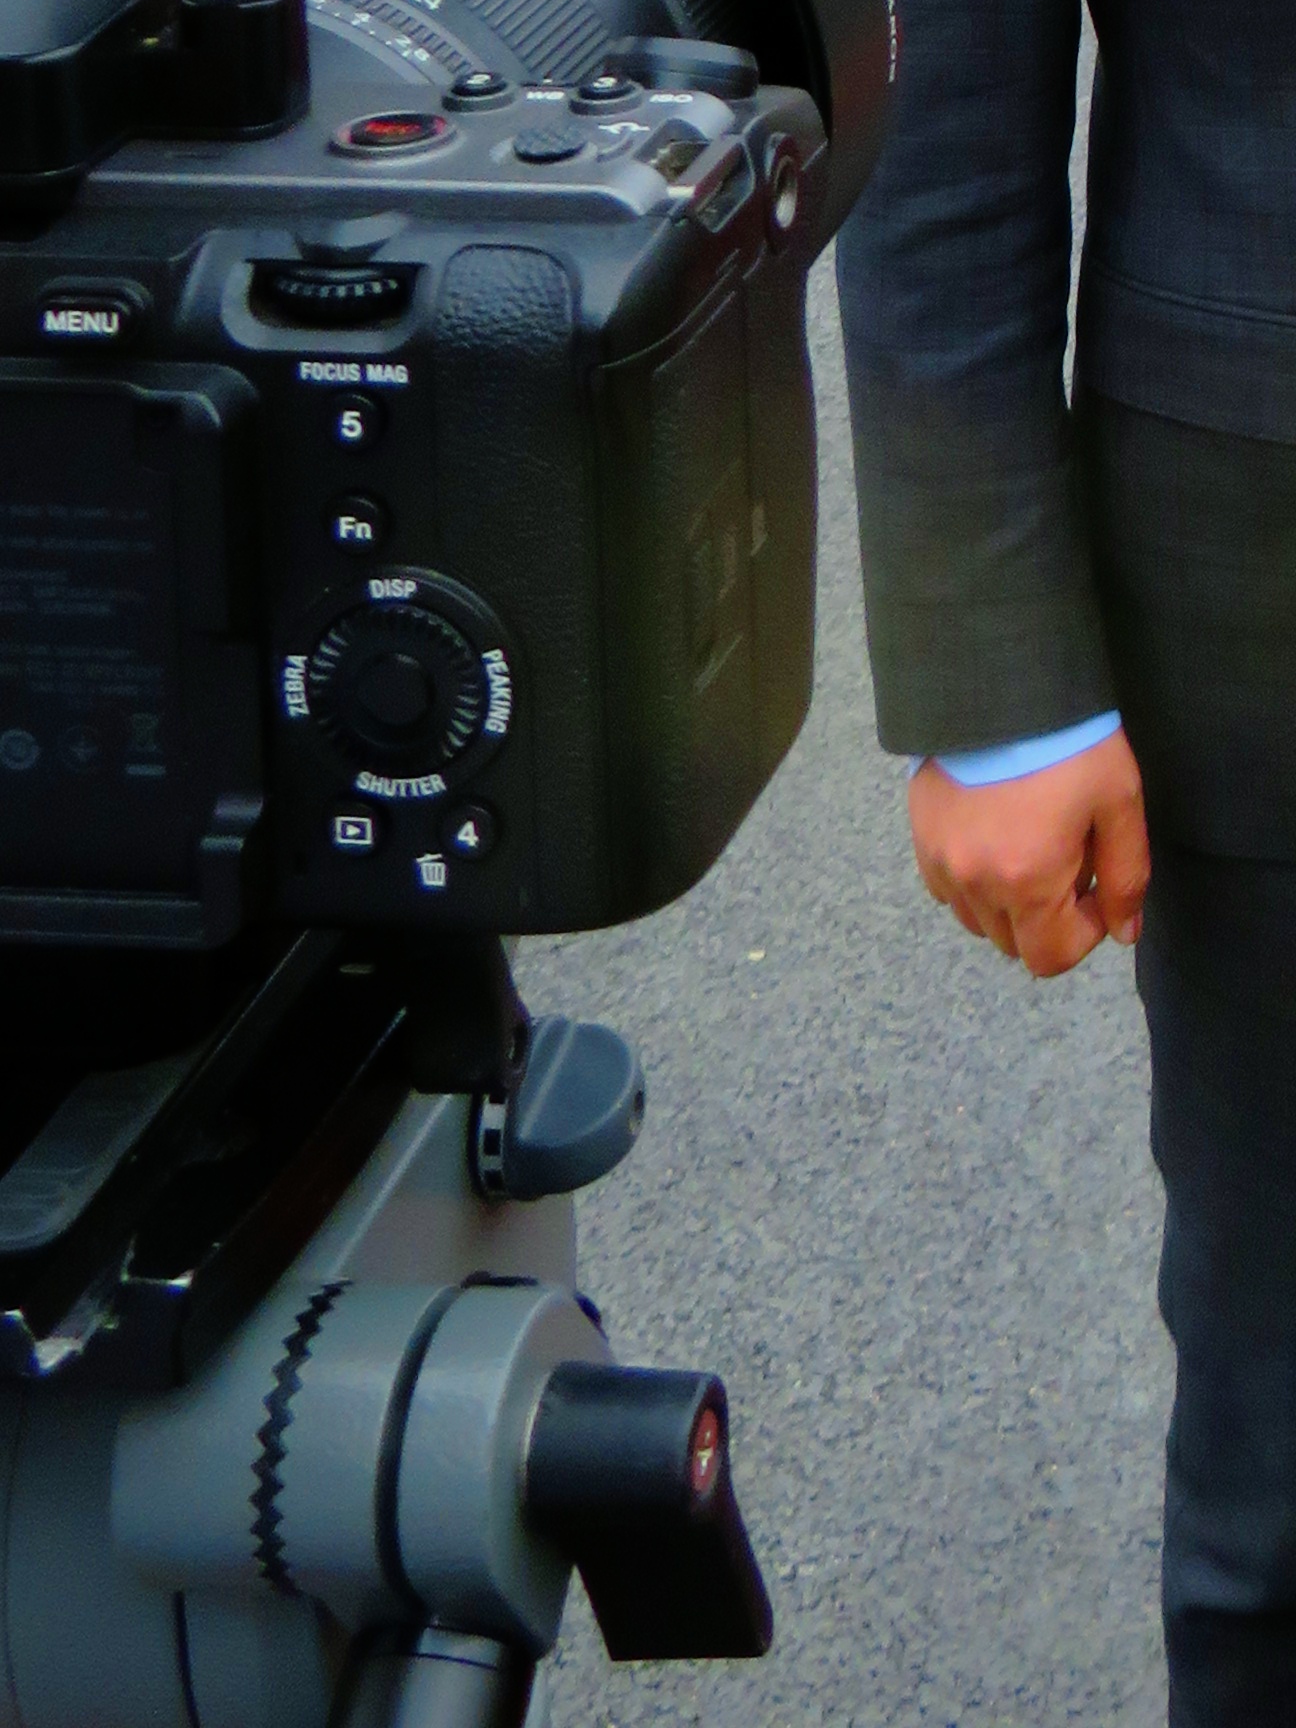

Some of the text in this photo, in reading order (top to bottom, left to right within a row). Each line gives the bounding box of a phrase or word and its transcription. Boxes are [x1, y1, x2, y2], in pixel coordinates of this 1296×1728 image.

[593, 77, 617, 88] 3
[44, 310, 118, 333] MENU
[300, 361, 408, 384] FOCUS MAG
[340, 411, 364, 439] 5
[338, 516, 373, 540] Fn
[369, 579, 416, 599] DISP
[286, 655, 309, 717] ZEBRA
[482, 649, 511, 734] PEAKING
[356, 771, 446, 796] SHUTTER
[457, 821, 479, 847] 4
